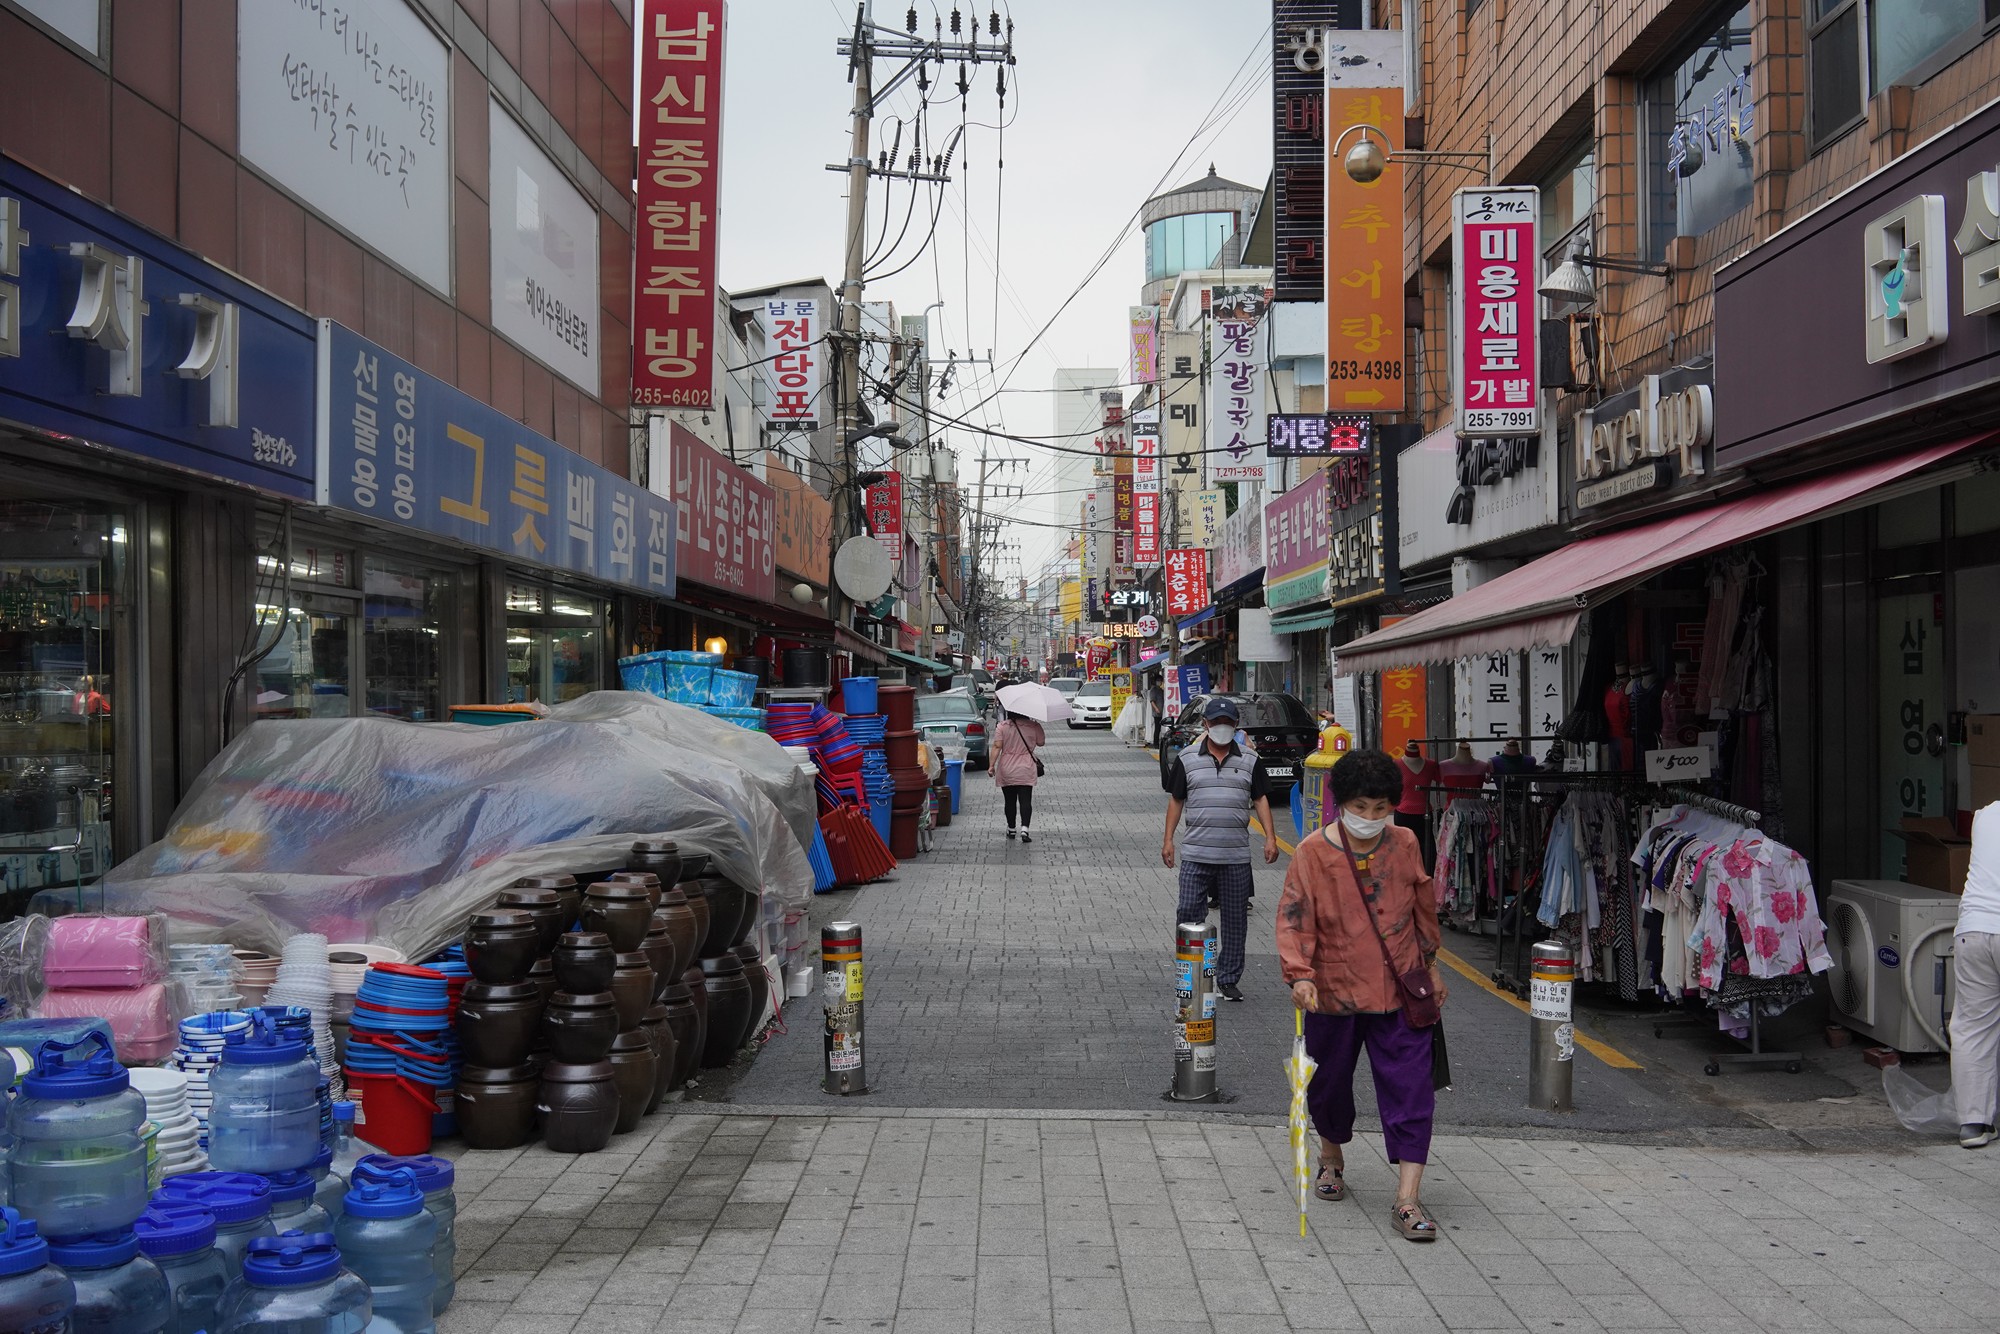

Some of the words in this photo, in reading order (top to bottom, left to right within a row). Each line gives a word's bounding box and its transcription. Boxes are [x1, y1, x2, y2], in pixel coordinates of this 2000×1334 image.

[333, 7, 349, 55] 더
[356, 30, 383, 84] 나은
[388, 64, 436, 146] 스타일을
[281, 52, 340, 151] 선택할
[345, 102, 359, 165] 수
[366, 124, 392, 177] 있는
[643, 10, 714, 379] 남신종합주방
[769, 301, 815, 317] 남문
[1219, 290, 1257, 314] 시골
[1477, 228, 1520, 372] 미용재료
[634, 387, 709, 406] 255-6402
[772, 318, 814, 418] 전당포
[1222, 323, 1257, 462] 팥칼국수
[1330, 360, 1401, 380] 253-4398
[351, 350, 380, 508] 선물용
[391, 371, 417, 520] 영업용
[1468, 412, 1533, 428] 255-7991
[1137, 439, 1156, 473] 가발
[1215, 467, 1264, 478] T.271-3788
[1619, 477, 1635, 494] party
[1636, 471, 1654, 487] dress
[675, 444, 774, 577] 남신종합주방
[1138, 496, 1155, 551] 미용재료
[1269, 485, 1327, 569] 꽃동네화원
[714, 562, 744, 588] 255-6402
[1167, 552, 1190, 612] 삼춘옥
[1138, 619, 1158, 633] 만두
